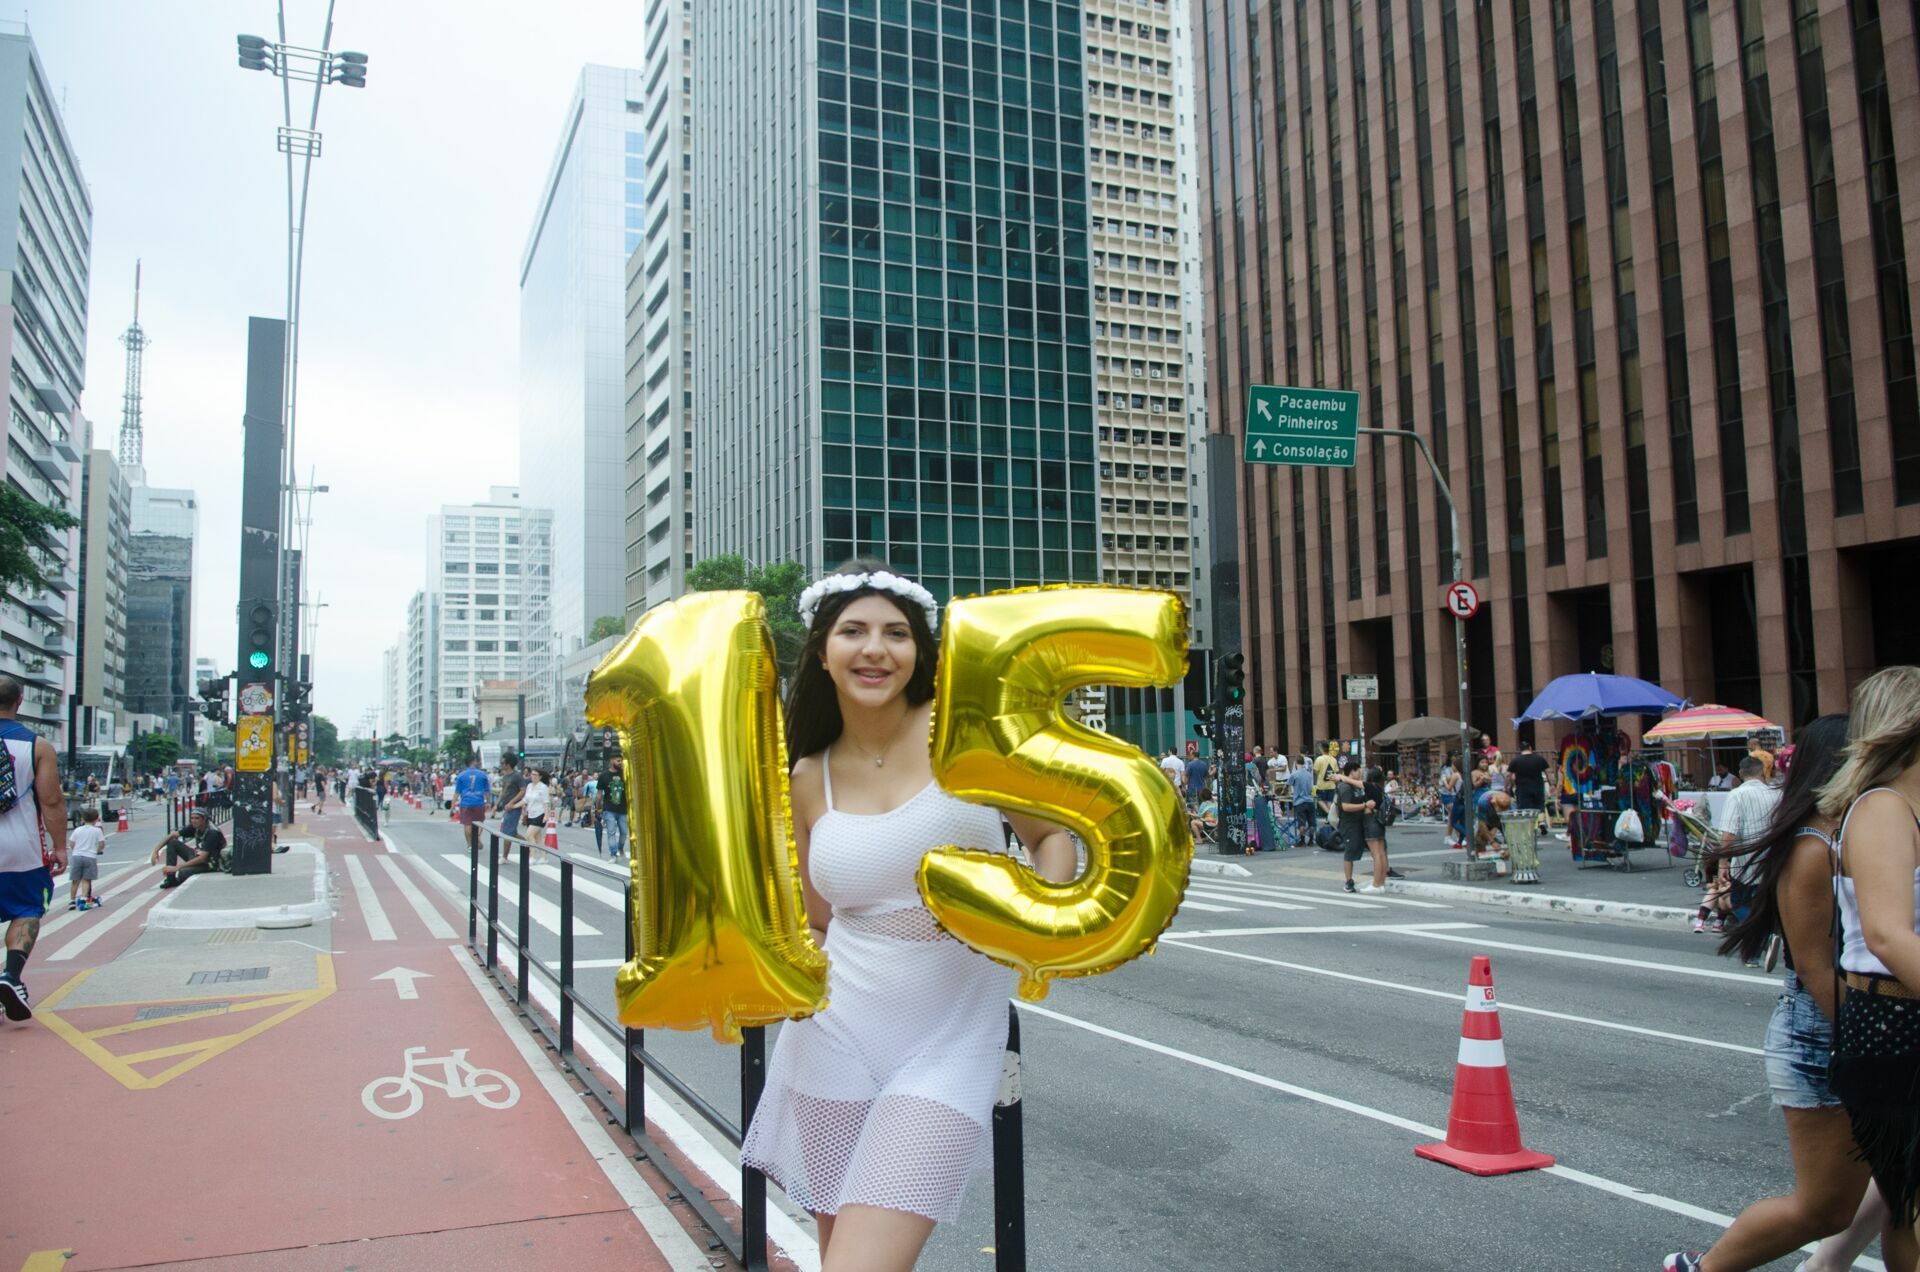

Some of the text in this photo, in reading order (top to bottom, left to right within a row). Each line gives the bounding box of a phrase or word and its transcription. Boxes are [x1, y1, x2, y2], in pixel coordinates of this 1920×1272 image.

[1279, 394, 1347, 413] Pacaembu
[1277, 415, 1339, 431] Pinheiros
[1272, 443, 1349, 461] Consolação
[1457, 589, 1468, 611] E
